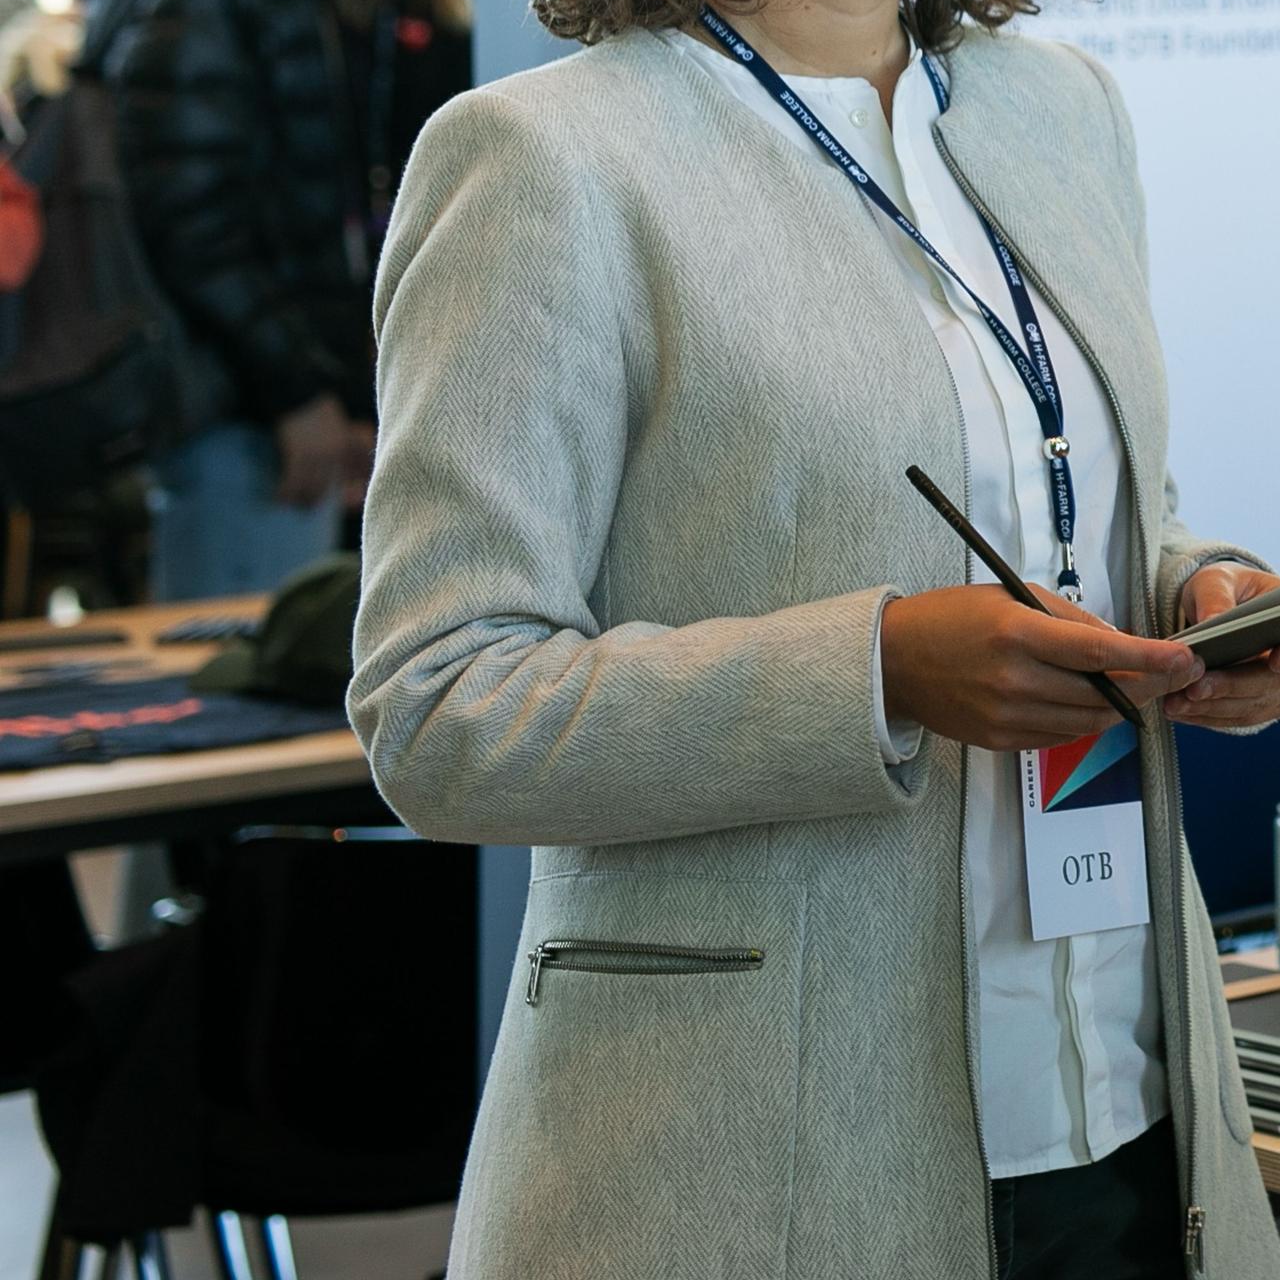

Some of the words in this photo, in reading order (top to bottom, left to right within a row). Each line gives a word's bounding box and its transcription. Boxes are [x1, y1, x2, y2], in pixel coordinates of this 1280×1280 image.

[703, 14, 736, 45] H-FARM
[780, 90, 818, 132] COLLEGE
[816, 130, 851, 165] H-FARM
[999, 245, 1021, 286] COLLEGE
[989, 319, 1019, 357] H-FARM
[1017, 357, 1047, 403] COLLEGE
[1033, 343, 1051, 383] H-FARM
[1055, 472, 1069, 516] H-FARM
[1026, 759, 1036, 808] CAREER
[1062, 851, 1113, 886] OTB
